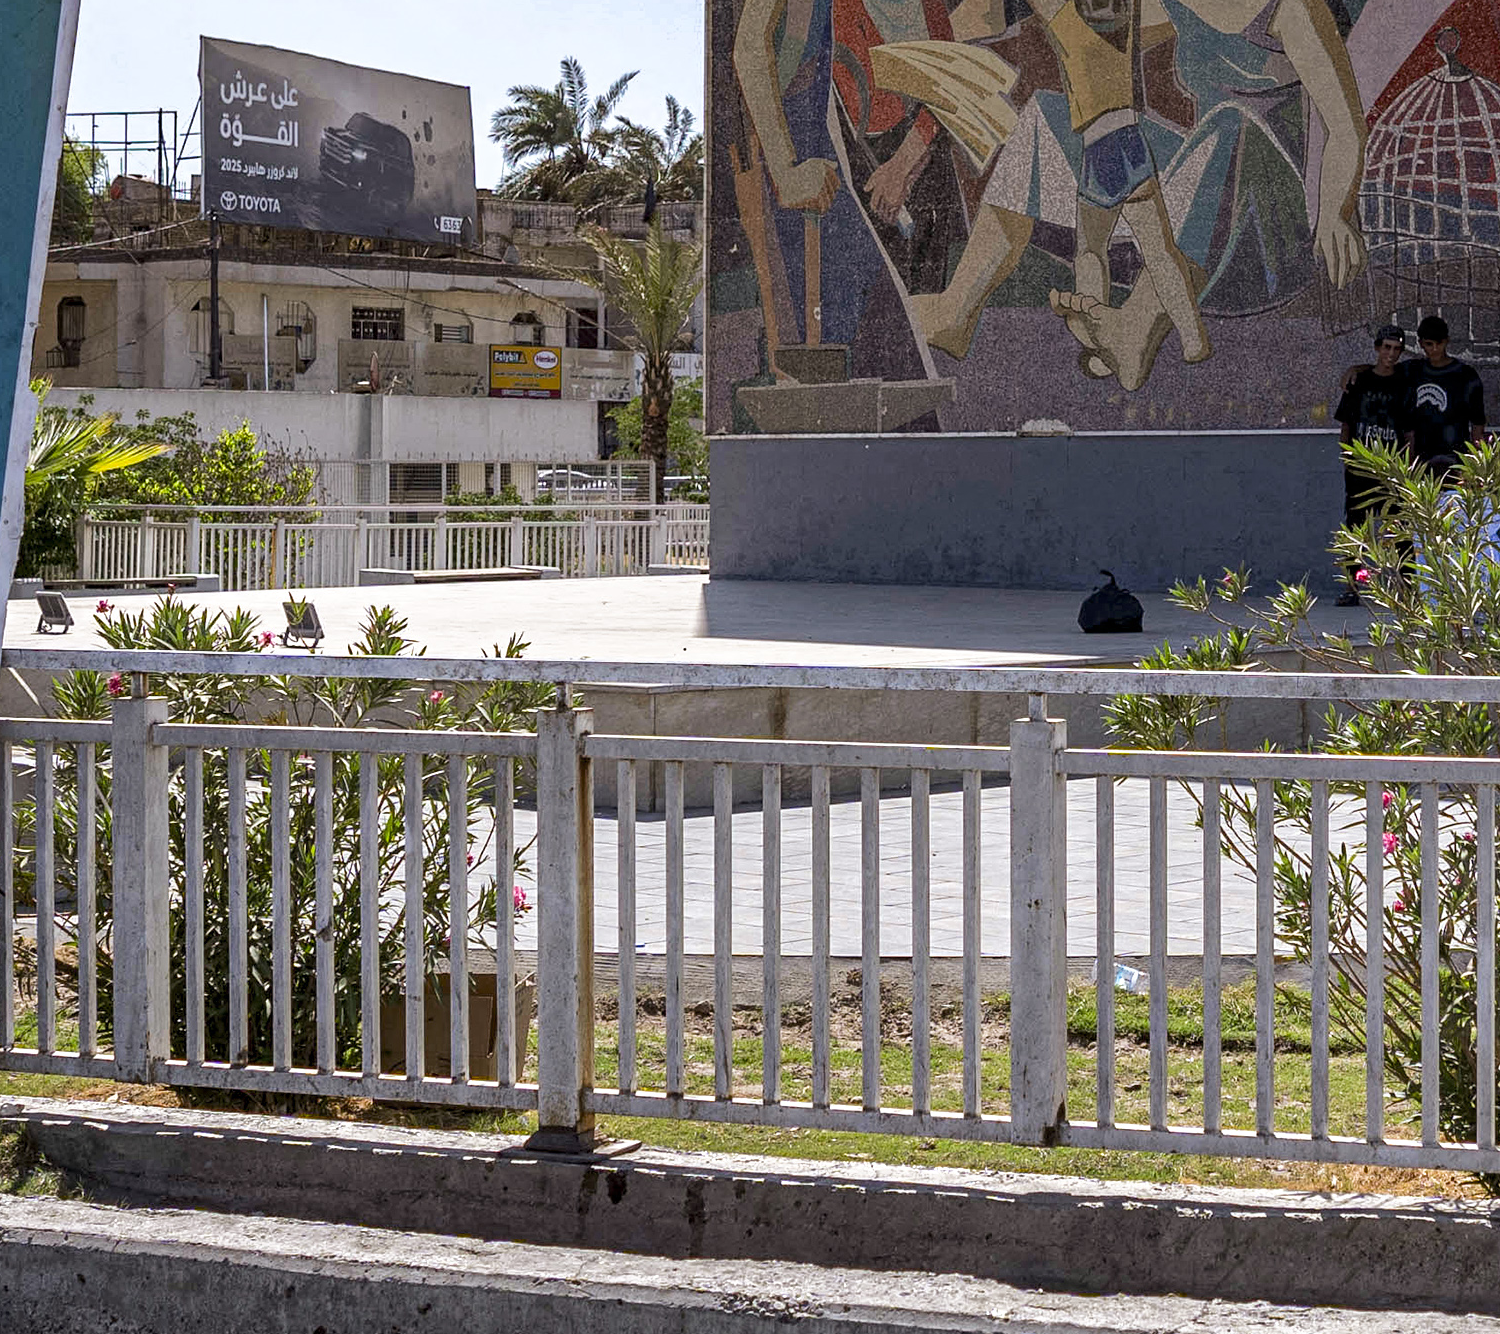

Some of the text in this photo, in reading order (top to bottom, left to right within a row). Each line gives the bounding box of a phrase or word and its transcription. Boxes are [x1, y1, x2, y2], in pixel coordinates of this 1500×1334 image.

[220, 71, 267, 107] عرش
[220, 158, 242, 173] 2025
[239, 195, 281, 213] TOYOTA
